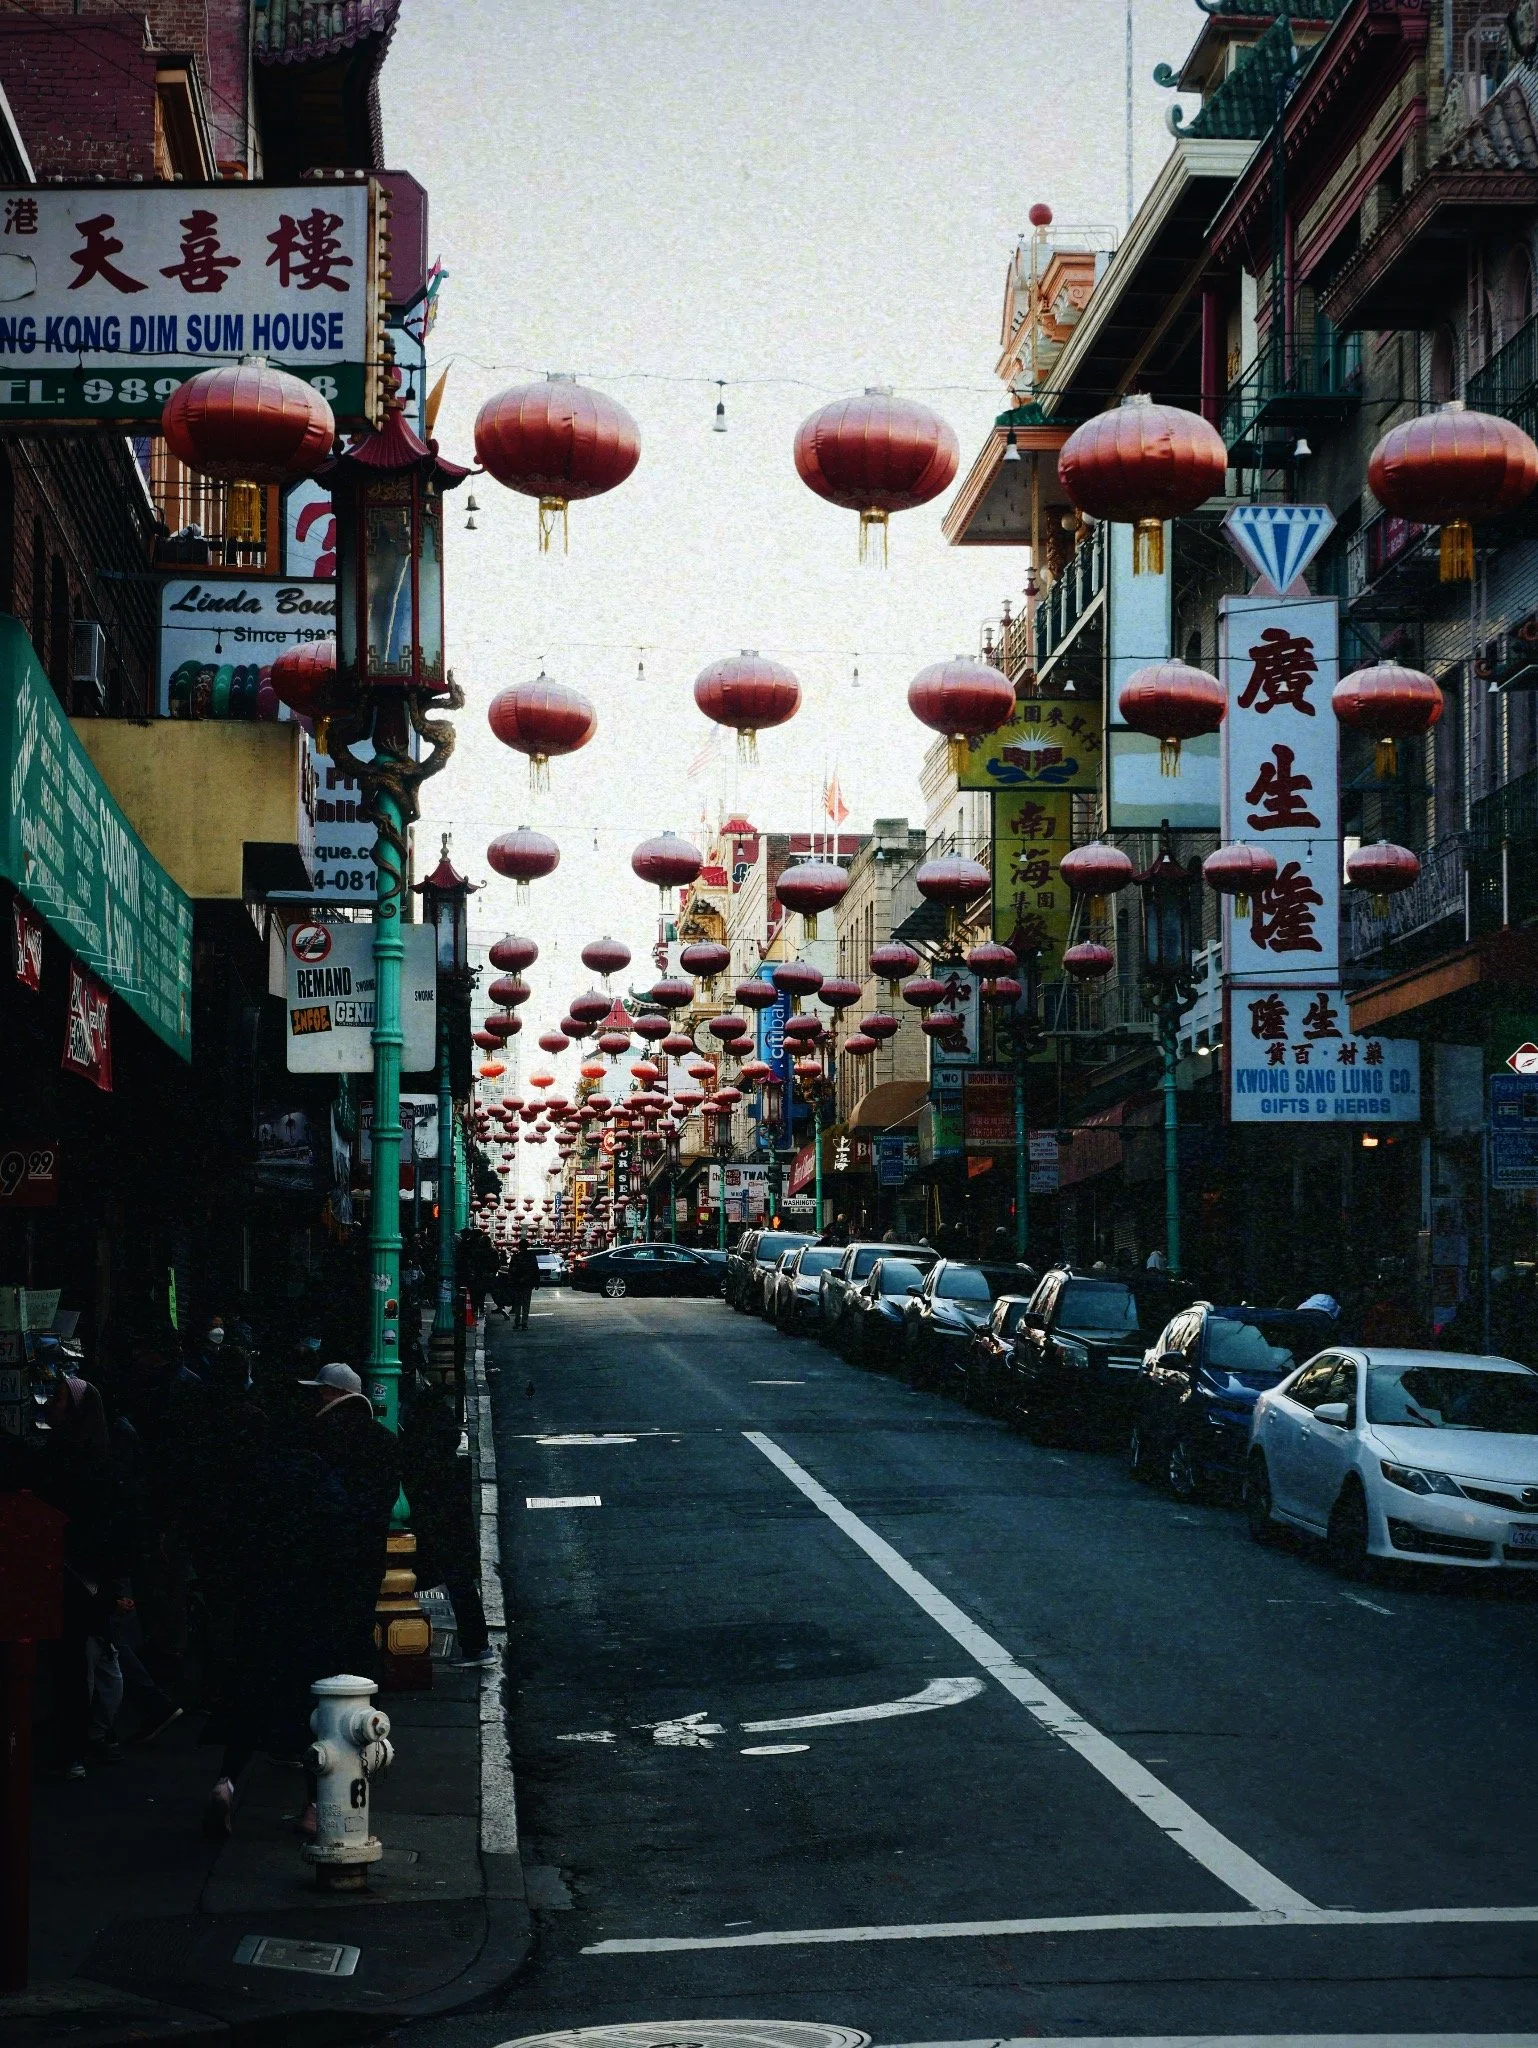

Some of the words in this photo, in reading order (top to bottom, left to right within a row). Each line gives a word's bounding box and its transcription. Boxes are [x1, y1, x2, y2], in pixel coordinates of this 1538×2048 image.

[3, 198, 38, 235] 港
[67, 208, 353, 293] 天喜樓
[45, 315, 120, 353] KONG
[130, 315, 177, 353] DIM
[186, 313, 243, 351] SUM
[253, 312, 344, 350] HOUSE
[169, 585, 263, 613] Linda
[234, 627, 286, 643] Since
[16, 664, 31, 736] THE
[11, 695, 39, 816] ULTIMATE
[1237, 628, 1323, 953] 廣生隆
[100, 797, 141, 923] SOUVENIR
[1010, 801, 1059, 889] 南海
[114, 903, 134, 989] SHOP
[296, 967, 352, 998] REMAND
[1236, 1068, 1289, 1093] KWONG
[1295, 1068, 1336, 1093] SANG
[1342, 1068, 1383, 1093] LUNG
[1390, 1068, 1416, 1093] CO.
[1261, 1099, 1310, 1113] GIFTS
[1334, 1098, 1391, 1113] HERBS
[833, 1136, 851, 1171] 上海
